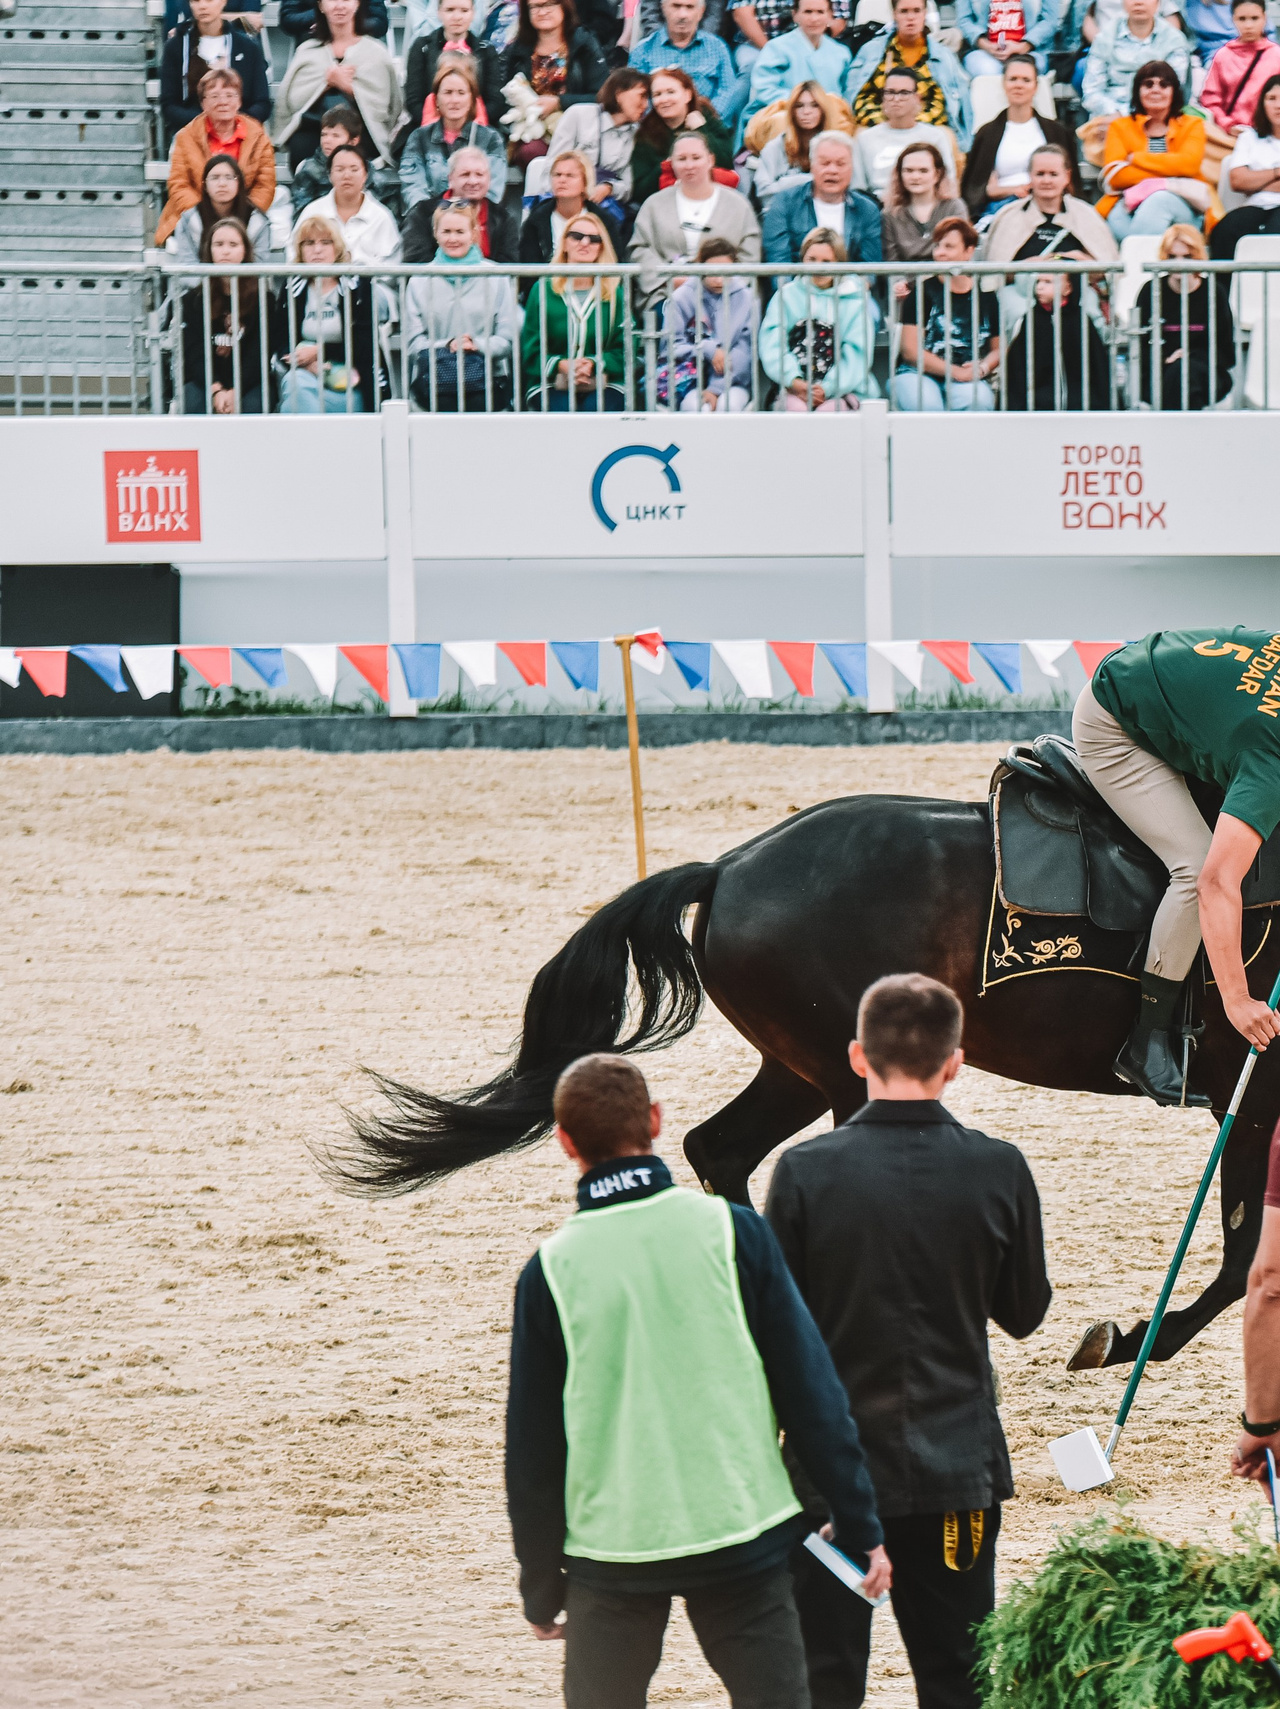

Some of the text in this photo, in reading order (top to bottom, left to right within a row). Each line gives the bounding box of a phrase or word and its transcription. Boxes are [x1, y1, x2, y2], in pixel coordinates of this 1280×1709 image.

[1061, 445, 1142, 467] ГОРОД
[1060, 471, 1143, 496] ЛЕТО
[118, 511, 190, 532] ВДНХ
[626, 505, 686, 522] ЦНКТ
[1063, 501, 1167, 529] ВДНХ
[1193, 638, 1254, 663] 5
[590, 1167, 652, 1199] ЦНКТ
